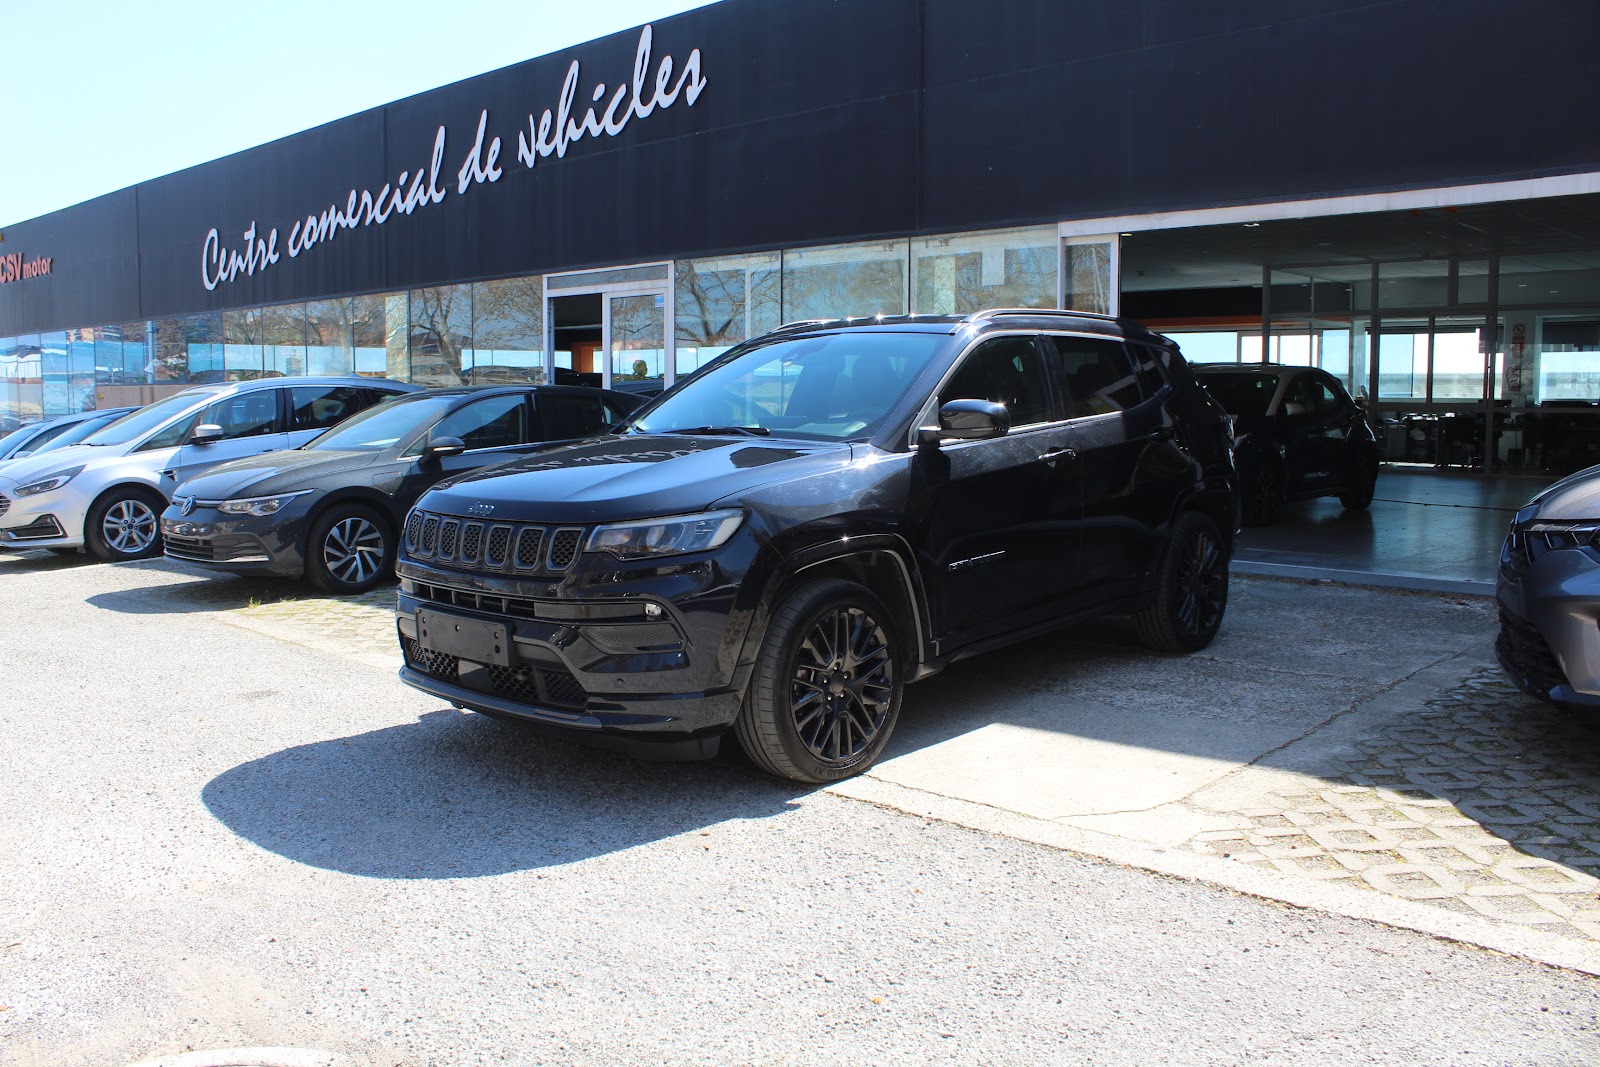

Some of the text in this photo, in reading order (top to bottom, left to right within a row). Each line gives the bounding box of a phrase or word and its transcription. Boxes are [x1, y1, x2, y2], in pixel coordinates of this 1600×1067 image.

[202, 24, 707, 291] Centre comercial de vehicles
[0, 251, 53, 283] CSV motor
